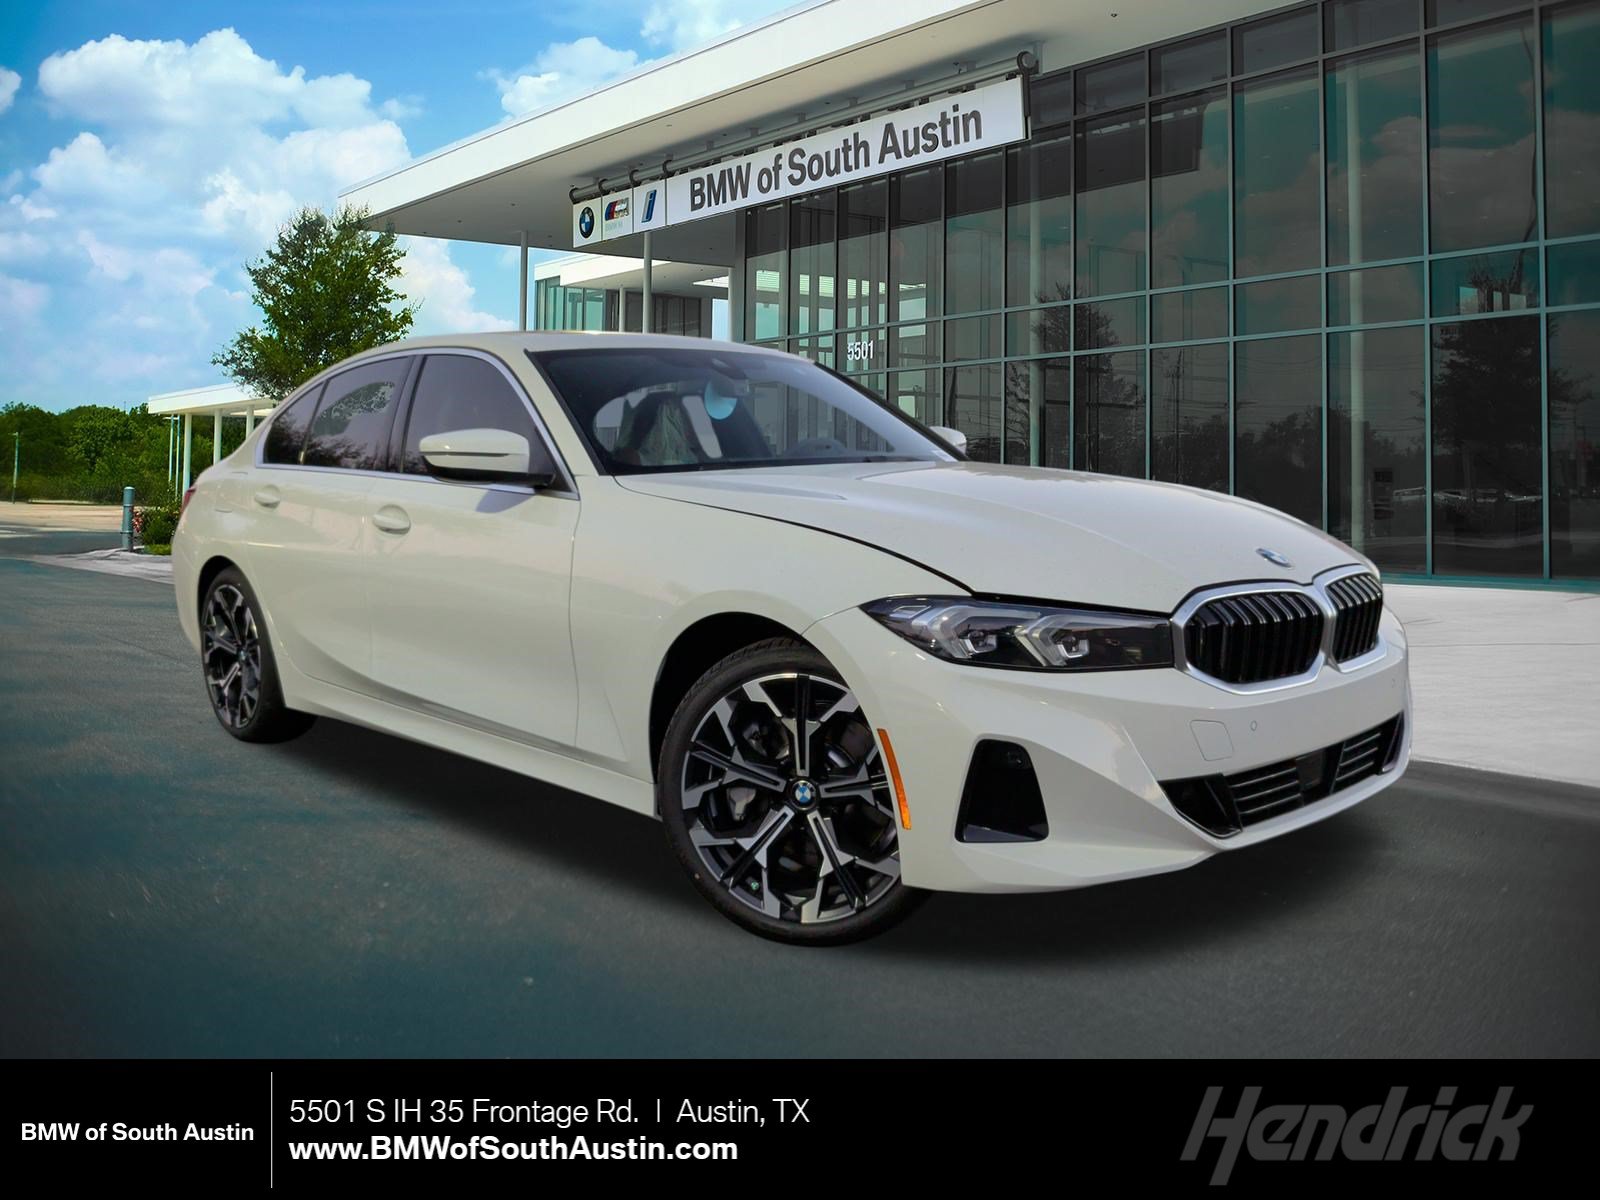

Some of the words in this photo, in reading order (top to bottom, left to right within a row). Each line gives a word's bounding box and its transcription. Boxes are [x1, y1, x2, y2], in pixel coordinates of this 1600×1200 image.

[690, 162, 752, 212] BMW
[757, 153, 783, 194] of
[787, 131, 871, 187] South
[878, 103, 983, 165] Austin
[847, 340, 874, 361] 5501
